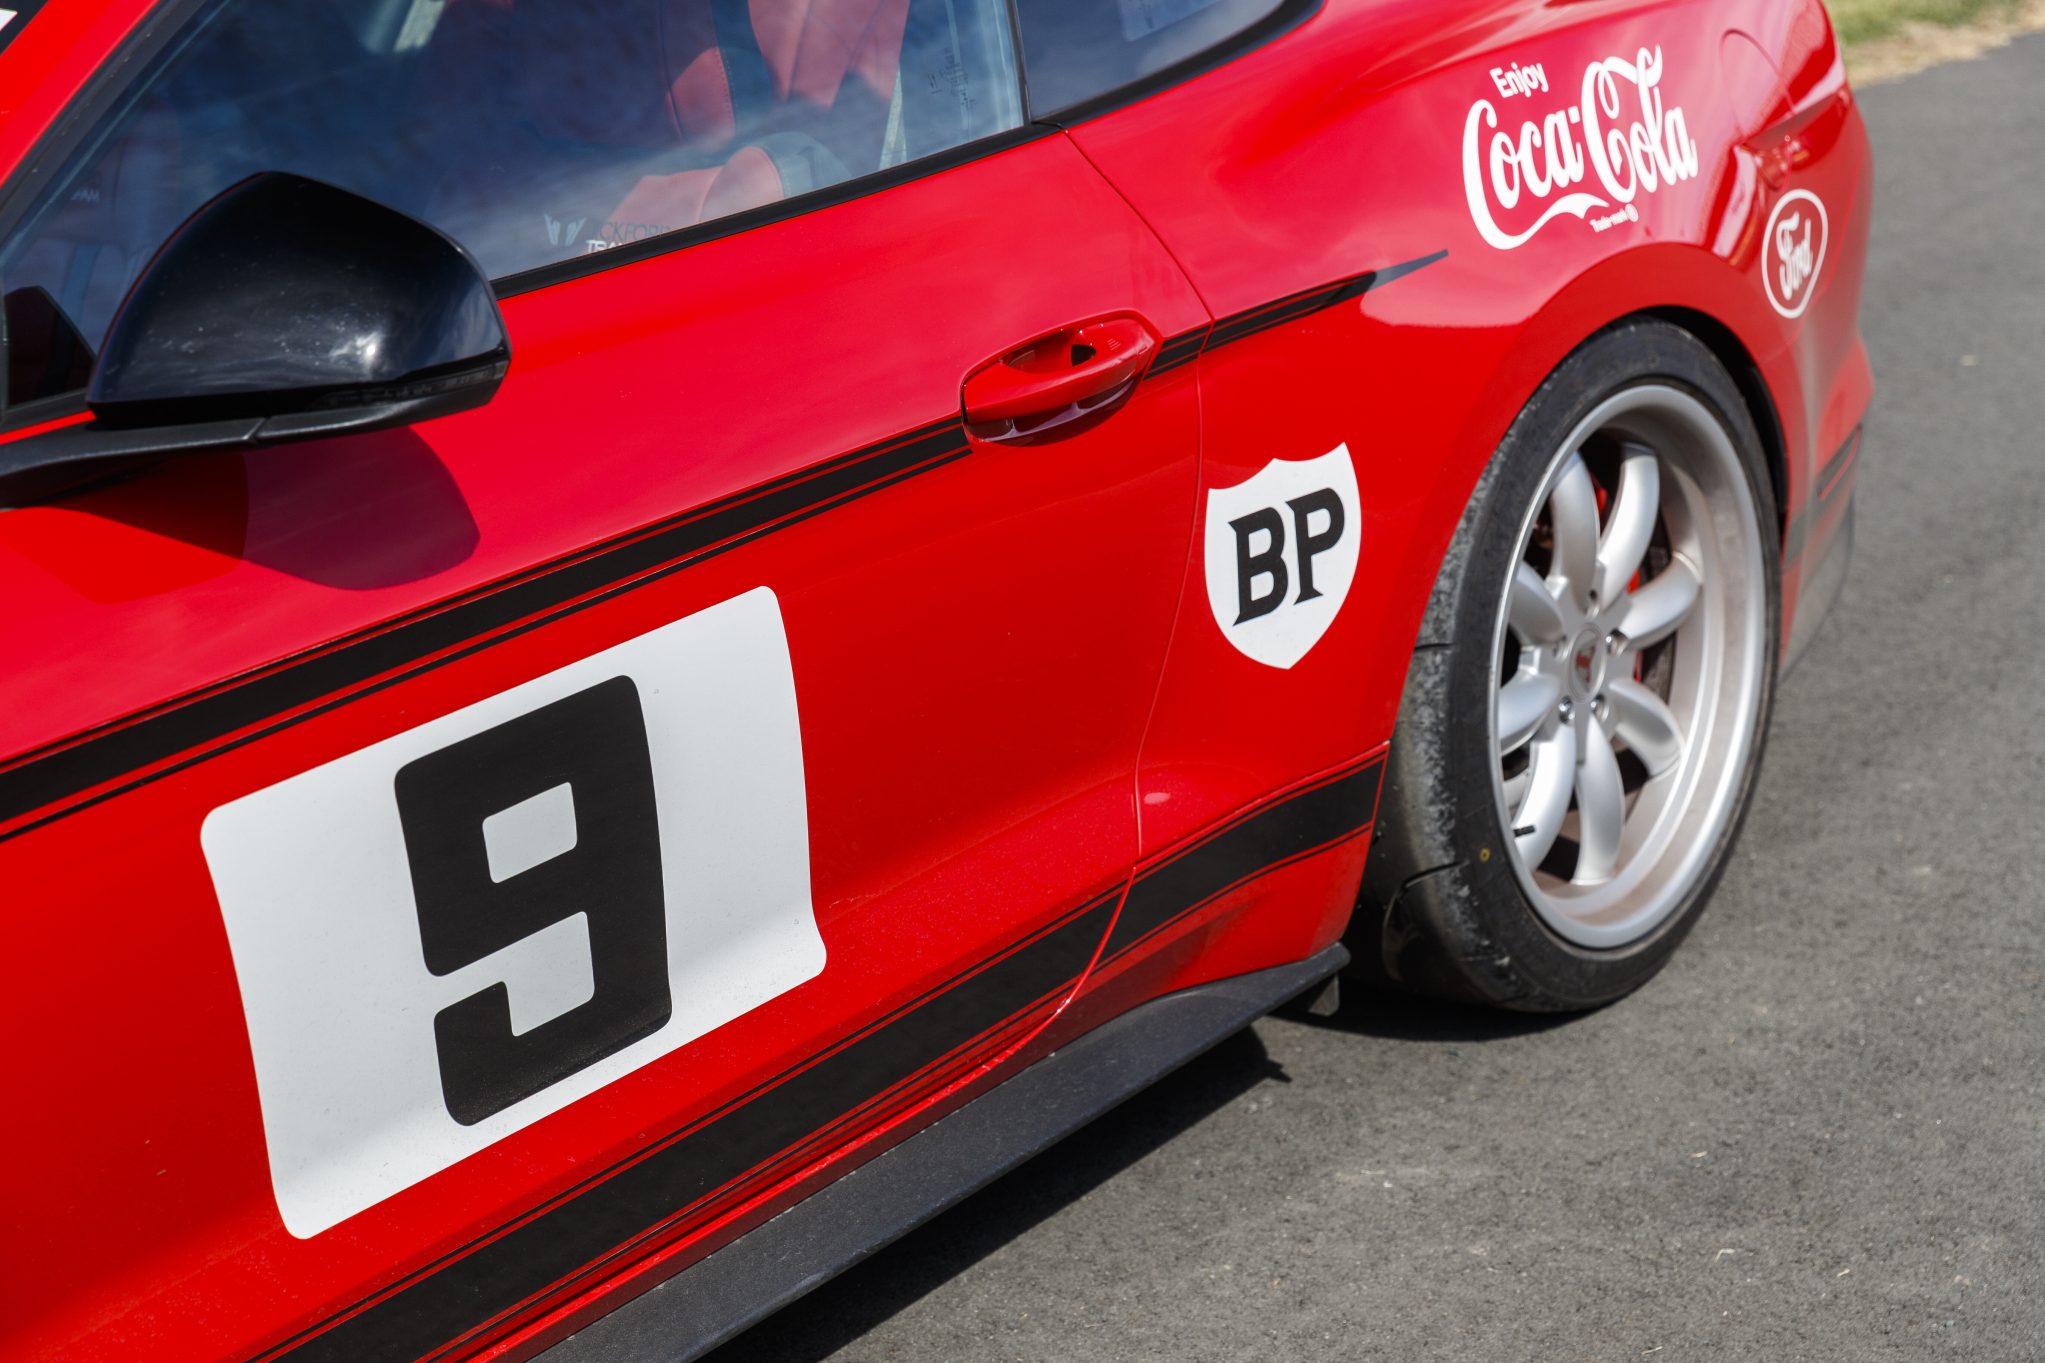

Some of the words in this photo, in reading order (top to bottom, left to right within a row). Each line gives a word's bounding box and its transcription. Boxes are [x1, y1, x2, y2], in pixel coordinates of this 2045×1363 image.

[1462, 44, 1699, 250] Coca-Cola
[1489, 61, 1549, 98] Enjoy
[1776, 211, 1813, 300] Ford
[1227, 487, 1345, 626] BP
[394, 674, 672, 1127] 9
